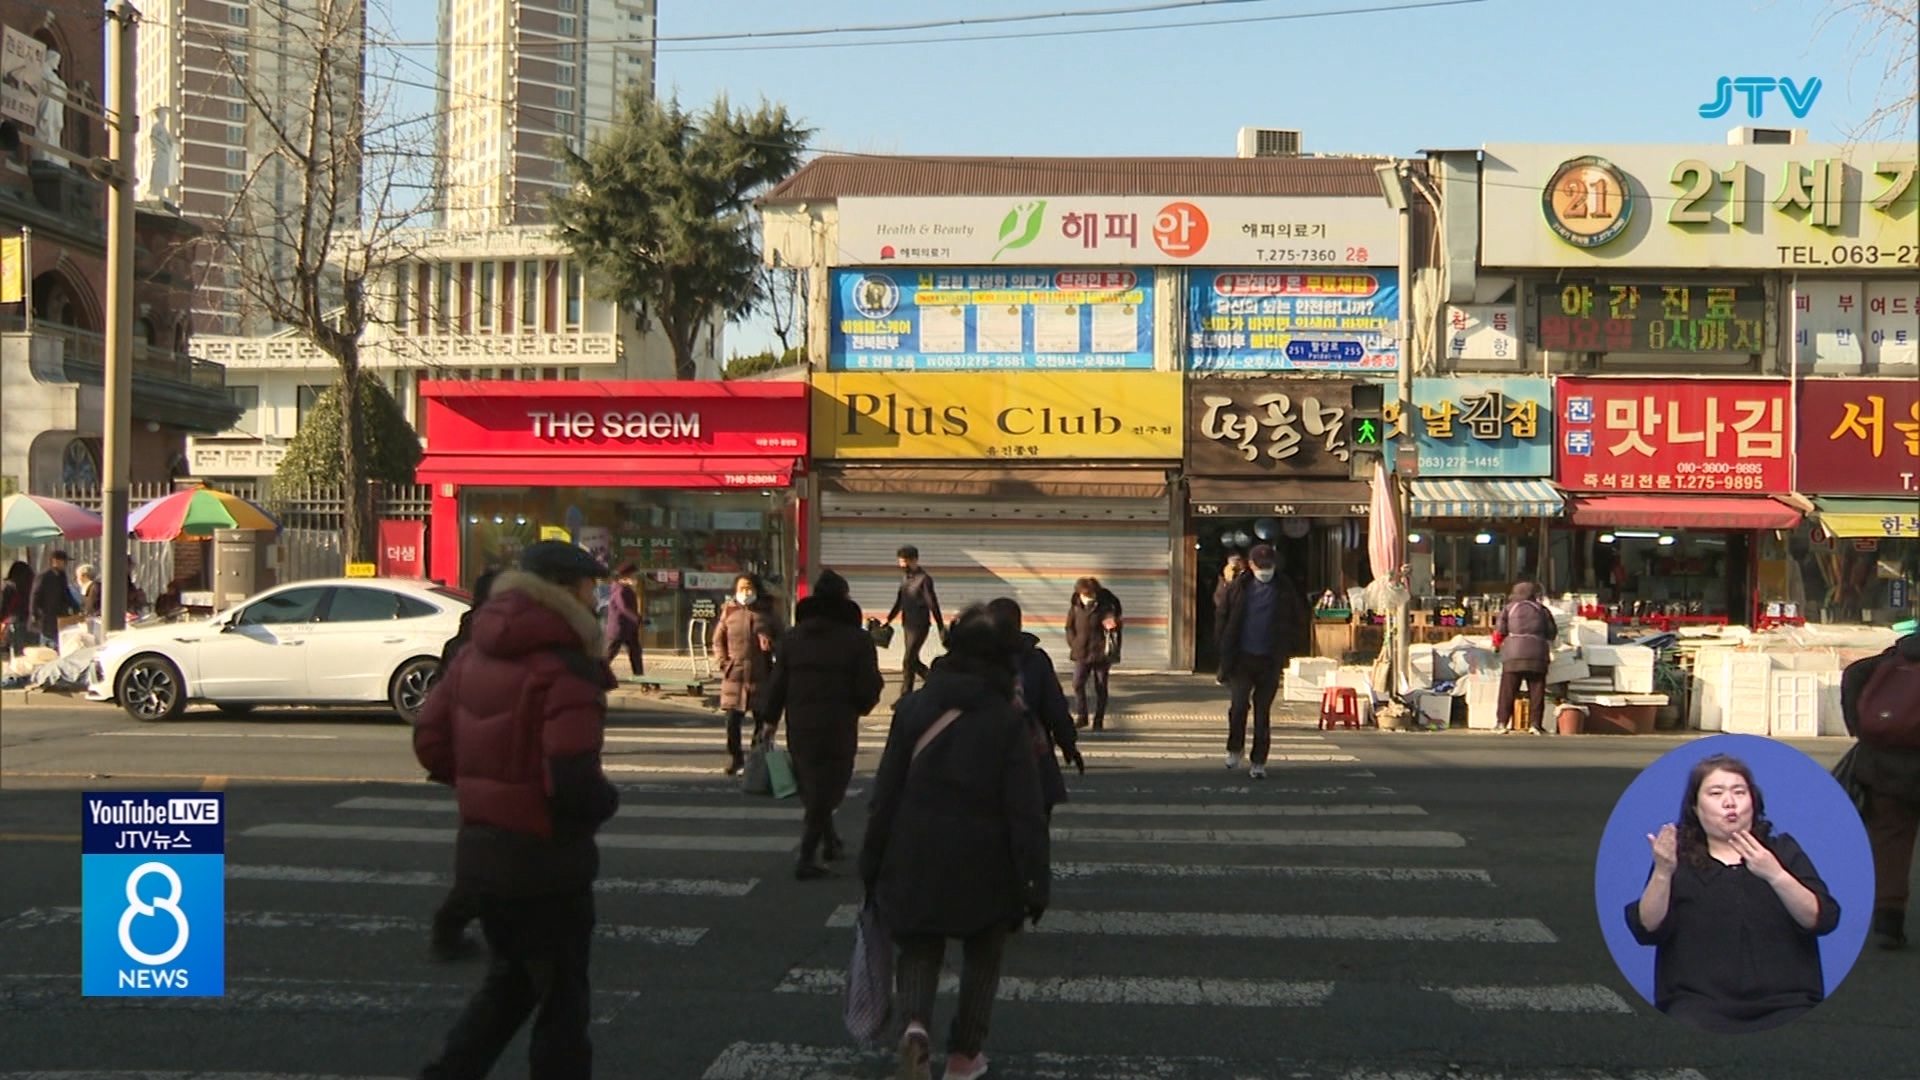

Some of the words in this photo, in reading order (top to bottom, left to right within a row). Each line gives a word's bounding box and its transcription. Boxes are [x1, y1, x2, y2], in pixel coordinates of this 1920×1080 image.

[1563, 178, 1612, 219] 21
[876, 224, 916, 235] Health
[919, 224, 929, 235] &
[933, 224, 975, 236] Beauty
[1241, 223, 1327, 239] 해피의료기
[900, 248, 950, 259] 해피의료기
[1257, 249, 1336, 262] T.275-7360
[1346, 247, 1369, 263] 2층
[1560, 285, 1737, 320] 야간진료
[1870, 297, 1919, 315] 여드
[1541, 316, 1633, 350] 월요일
[1649, 319, 1761, 351] 8시까지
[1288, 346, 1304, 355] 251
[1344, 347, 1361, 356] 255
[842, 392, 968, 437] Plus
[996, 407, 1122, 436] Club
[1605, 397, 1784, 459] 맛나김
[1583, 473, 1672, 489] 즉석김전문
[1675, 475, 1763, 489] T.275-9895
[387, 546, 416, 562] 더샘
